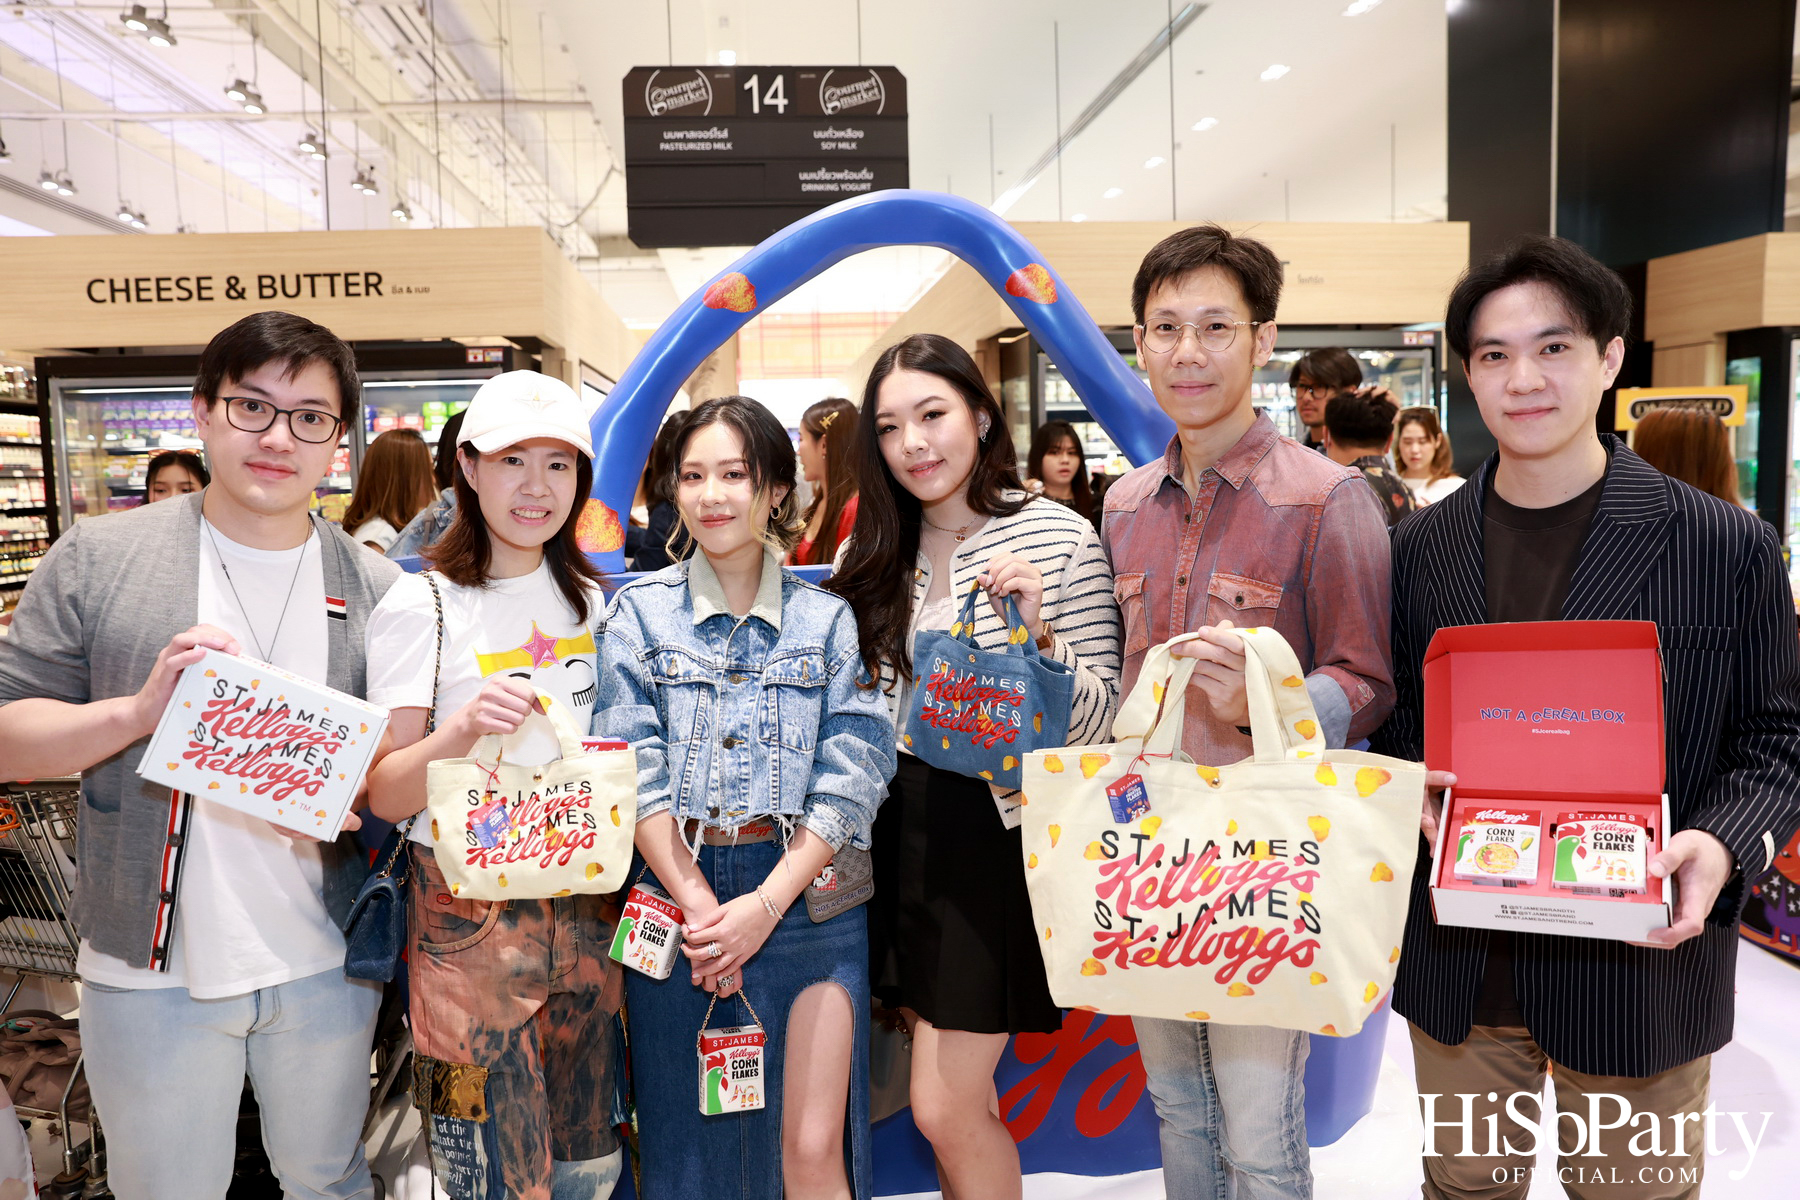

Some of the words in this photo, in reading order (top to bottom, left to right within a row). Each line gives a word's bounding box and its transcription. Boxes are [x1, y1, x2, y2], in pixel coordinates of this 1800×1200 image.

[742, 74, 788, 114] 14
[660, 142, 712, 151] PASTEURIZED
[713, 141, 733, 150] MILK
[821, 141, 836, 150] SOY
[837, 141, 858, 150] MILK
[801, 183, 839, 192] DRINKING
[840, 182, 872, 191] YOGURT
[87, 276, 214, 303] CHEESE
[225, 276, 247, 300] &
[257, 272, 384, 300] BUTTER
[1480, 707, 1512, 720] NOT
[1516, 709, 1527, 721] A
[1531, 707, 1589, 723] CEREAL
[1591, 708, 1625, 723] BOX
[182, 740, 325, 801] Kellogg's
[1475, 809, 1529, 823] Kellogg's
[1568, 813, 1636, 821] ST.JAMES
[1486, 827, 1515, 837] CORN
[1590, 822, 1638, 835] Kellogg's
[1485, 835, 1515, 843] FLAKES
[1593, 832, 1634, 843] CORN
[1099, 829, 1320, 868] ST.JAMES
[1593, 841, 1634, 853] FLAKES
[1095, 843, 1320, 918] Kellogg's
[635, 892, 676, 916] ST.JAMES
[643, 911, 673, 929] Kellogg's
[1094, 889, 1322, 943] ST.JAMES
[642, 920, 669, 939] CORN
[639, 930, 666, 947] FLAKES
[1092, 918, 1321, 985] Kellogg's
[712, 1035, 759, 1048] ST.JAMES
[729, 1048, 760, 1060] Kellogg's
[731, 1058, 759, 1071] CORN
[731, 1068, 759, 1080] FLAKES
